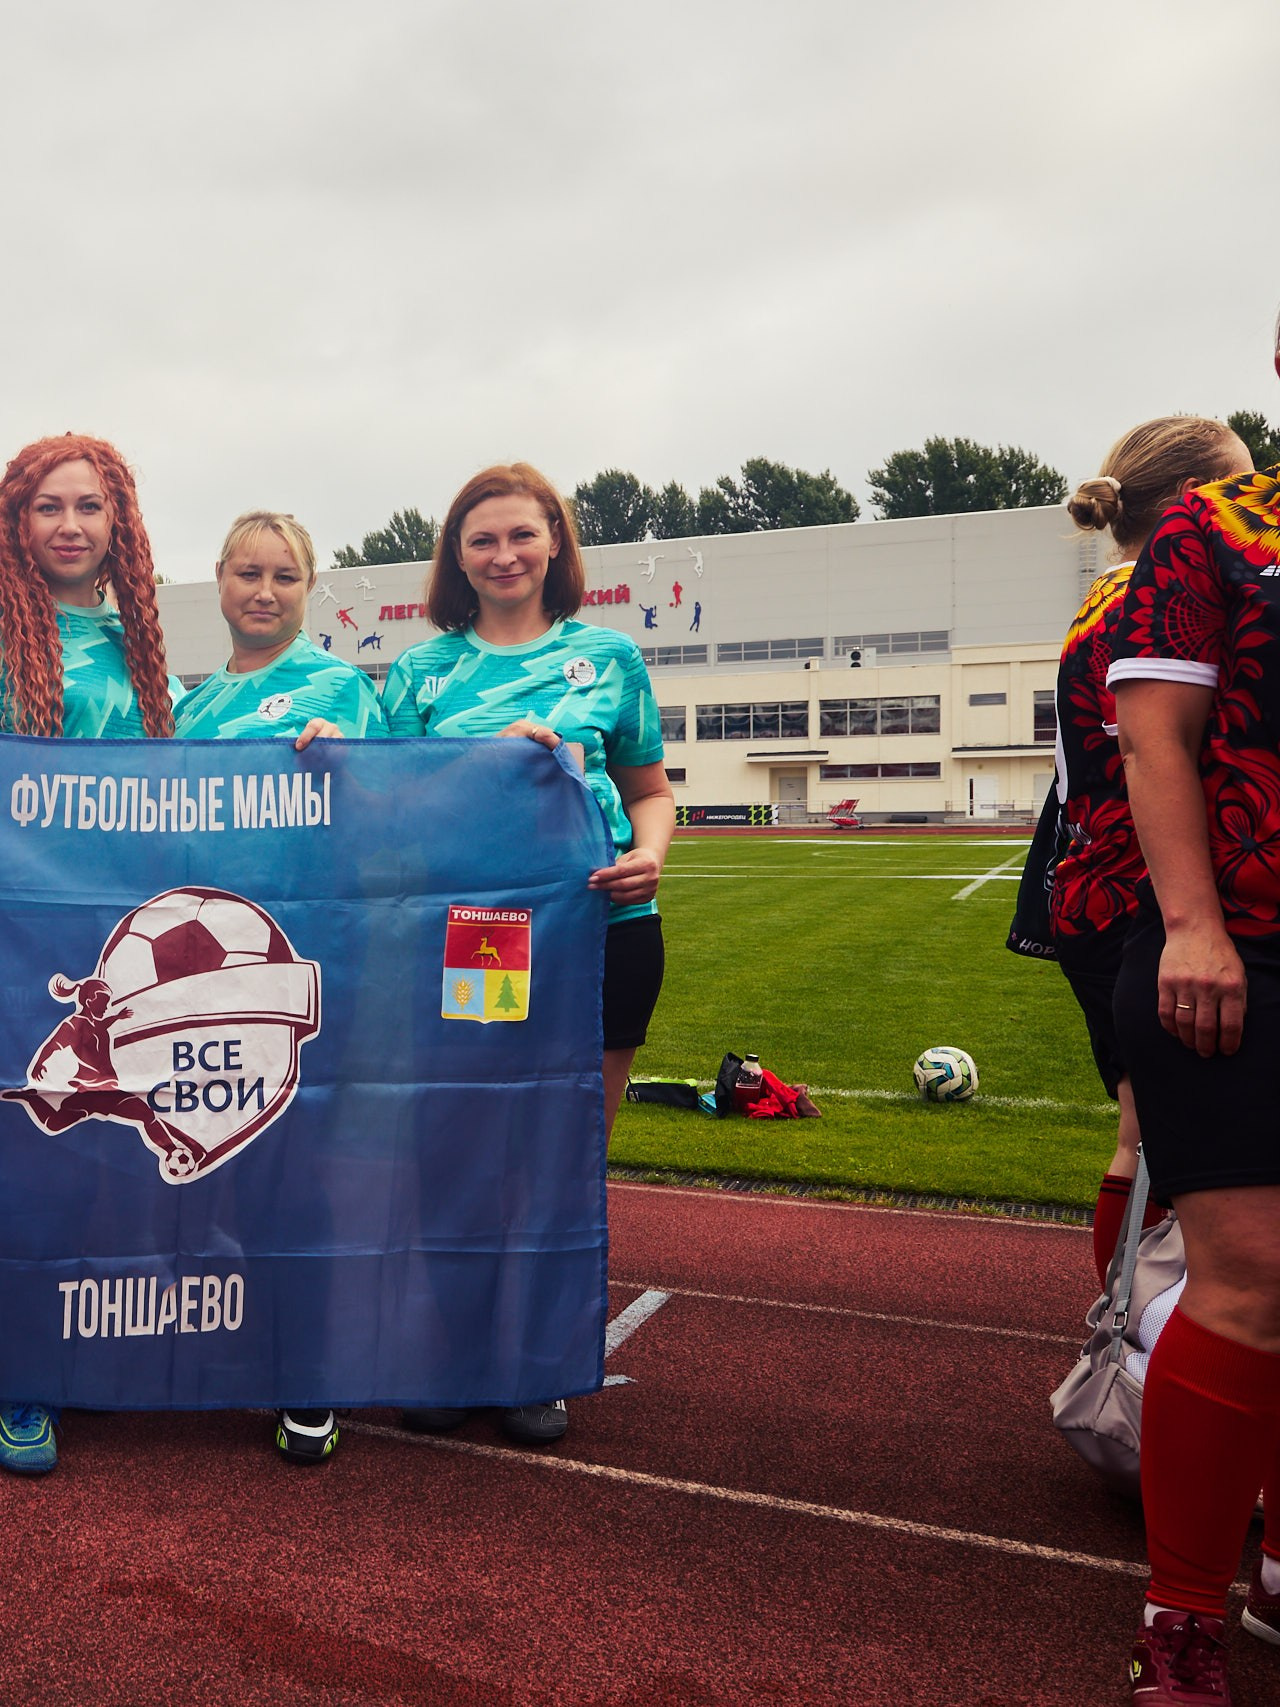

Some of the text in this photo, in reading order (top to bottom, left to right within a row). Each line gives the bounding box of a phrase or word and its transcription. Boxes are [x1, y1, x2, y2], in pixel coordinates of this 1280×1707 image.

[10, 772, 331, 832] ФУТБОЛЬНЫЕ МАМЫ
[452, 909, 528, 922] ТОНШАЕВО
[173, 1040, 243, 1071] ВСЕ
[147, 1077, 266, 1113] СВОИ
[58, 1273, 245, 1339] ТОНШАЕВО
